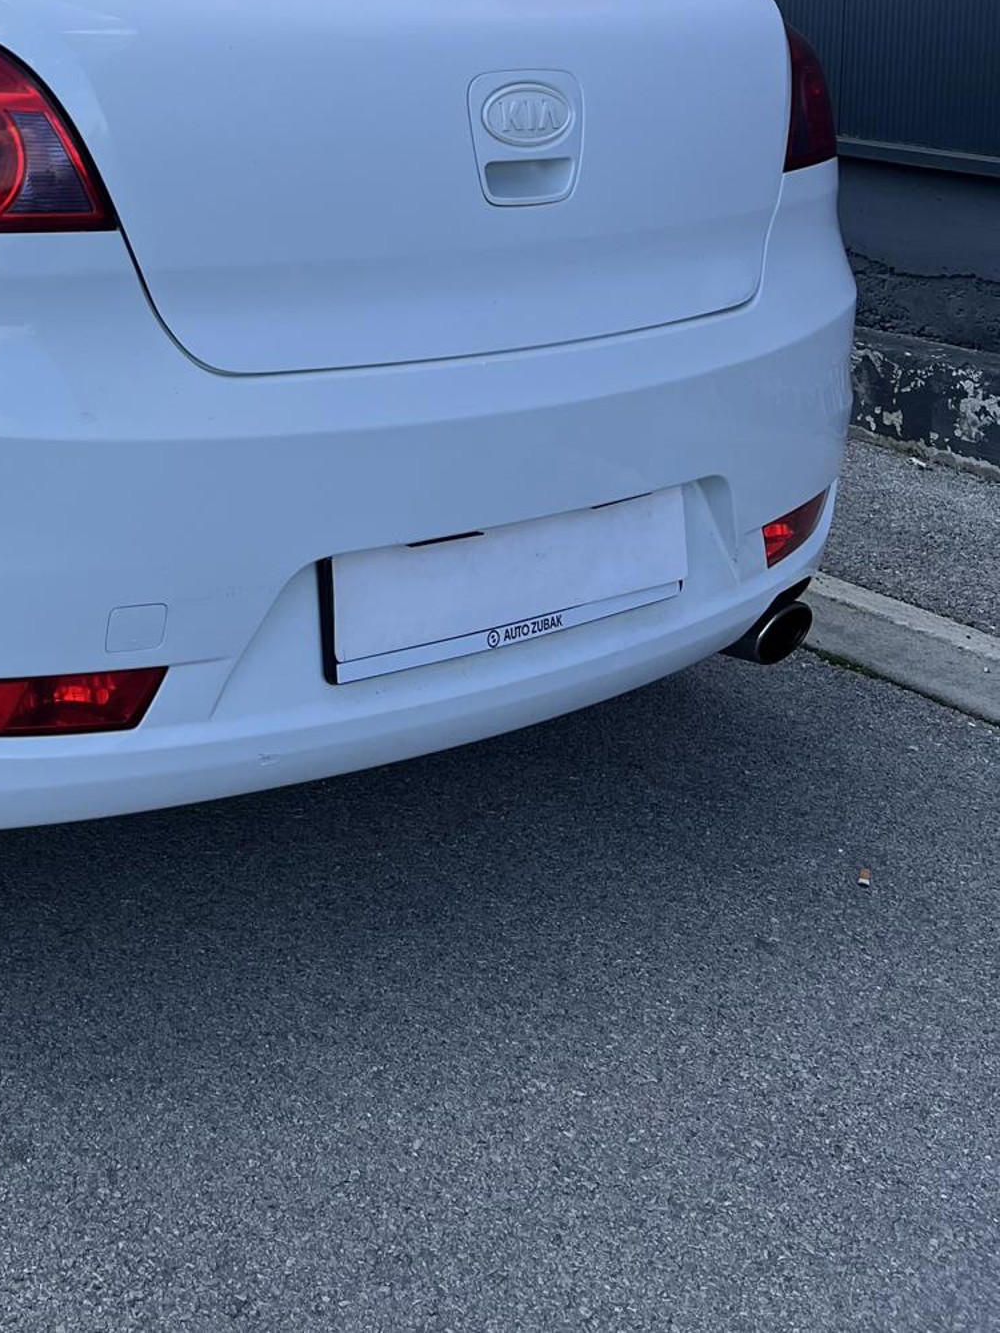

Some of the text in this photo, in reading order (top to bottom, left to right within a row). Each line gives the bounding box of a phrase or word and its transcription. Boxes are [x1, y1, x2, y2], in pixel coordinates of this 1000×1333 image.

[499, 98, 560, 133] KIA
[503, 614, 563, 642] AUTO ZUBAK
